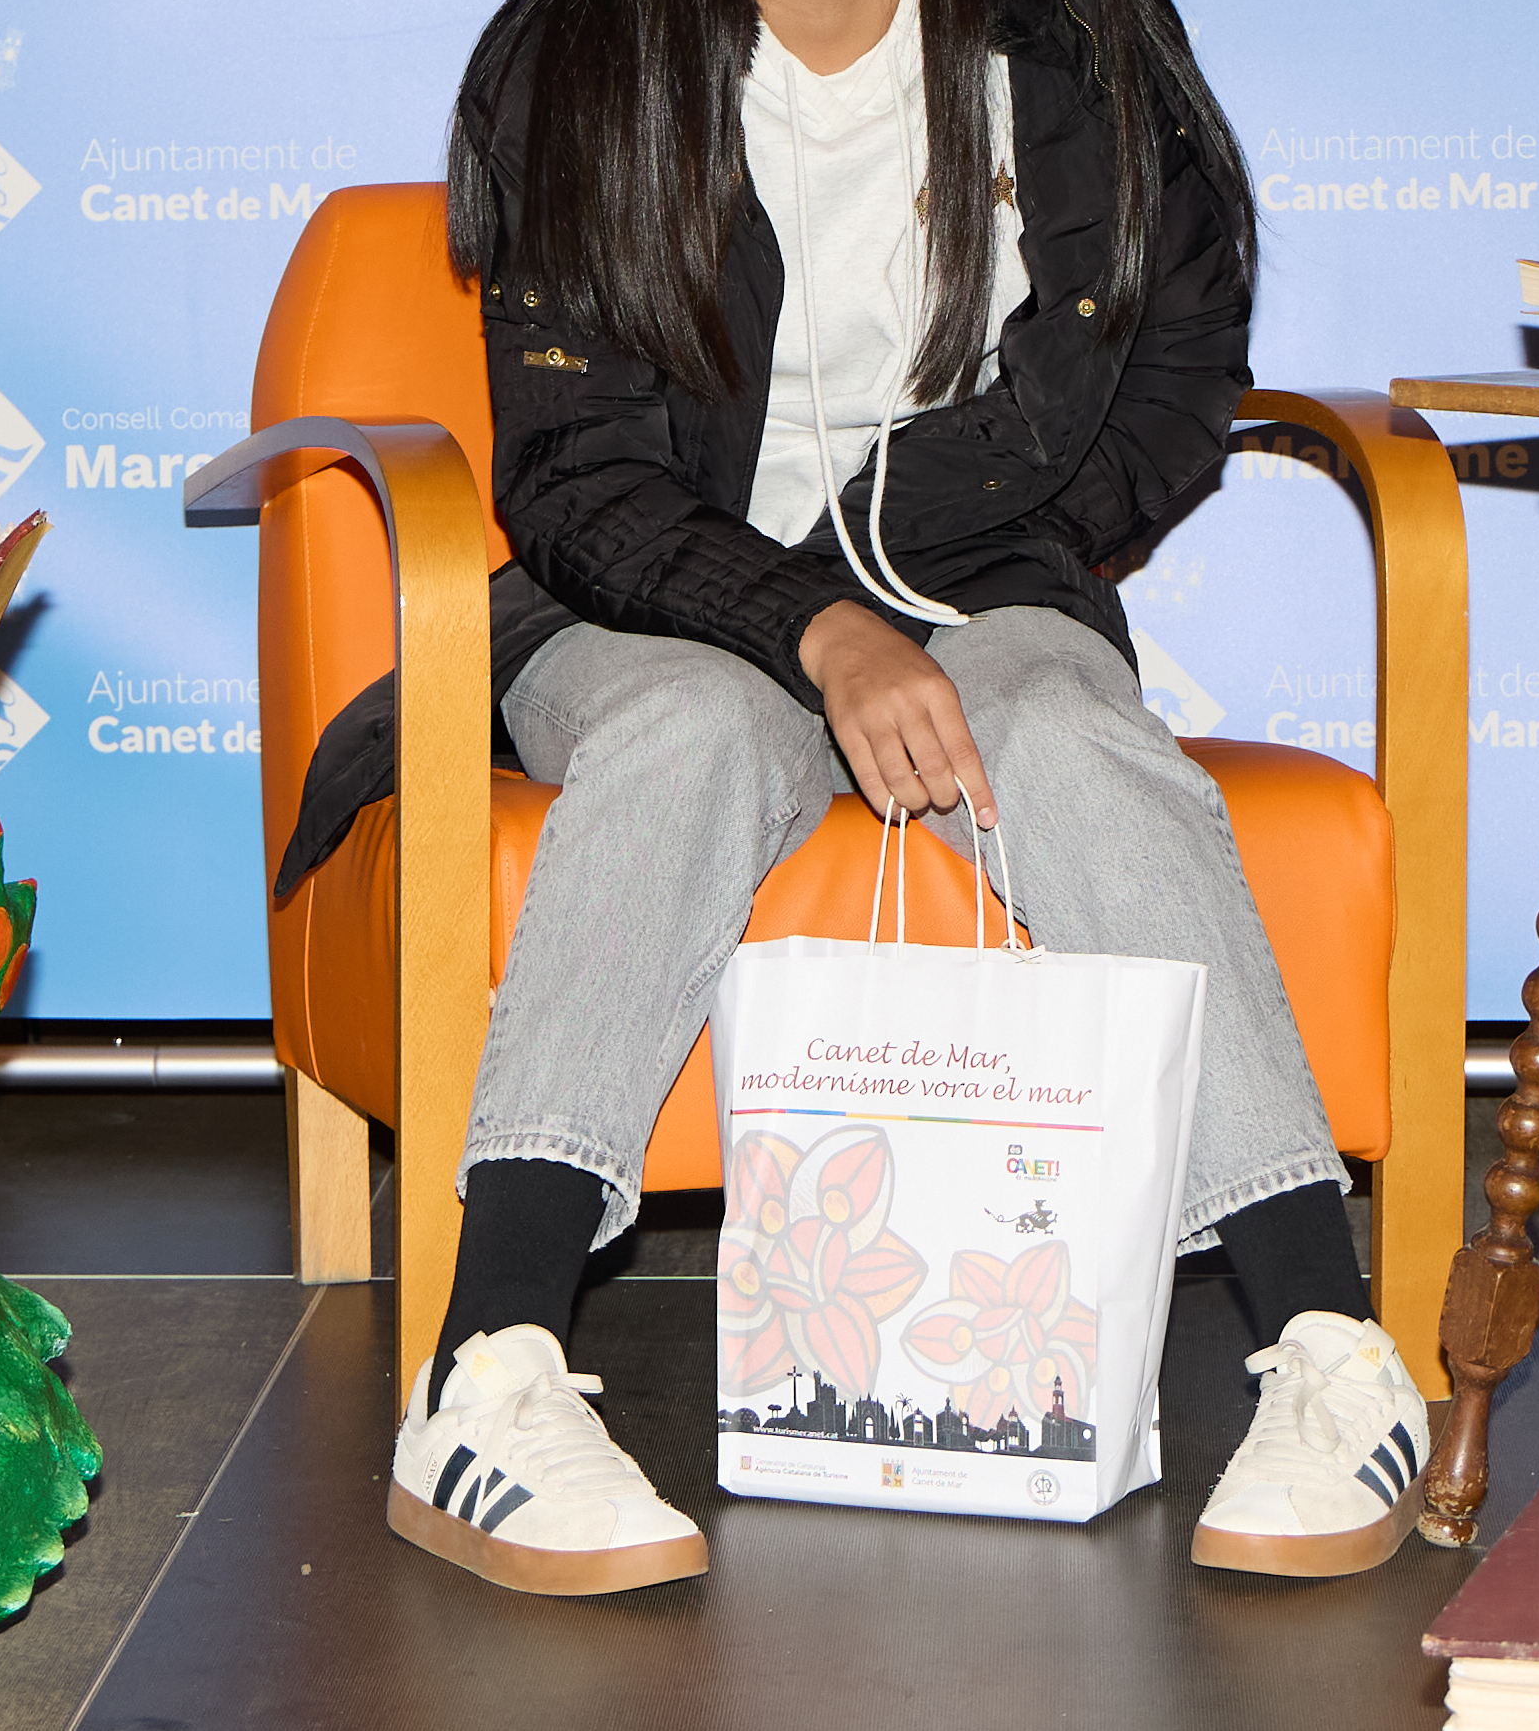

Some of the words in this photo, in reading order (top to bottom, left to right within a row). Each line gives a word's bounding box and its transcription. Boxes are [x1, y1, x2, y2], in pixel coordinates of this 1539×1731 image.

[1258, 127, 1481, 169] Ajuntament
[1491, 125, 1537, 160] de
[1257, 172, 1389, 212] Canet
[1395, 176, 1442, 211] de
[1448, 171, 1539, 211] Mar
[807, 1038, 897, 1064] Canet
[901, 1040, 942, 1067] de
[946, 1042, 1012, 1075] Mar,
[741, 1065, 916, 1096] modernisme
[920, 1078, 988, 1099] vora
[992, 1077, 1022, 1102] el
[1028, 1083, 1092, 1106] mar
